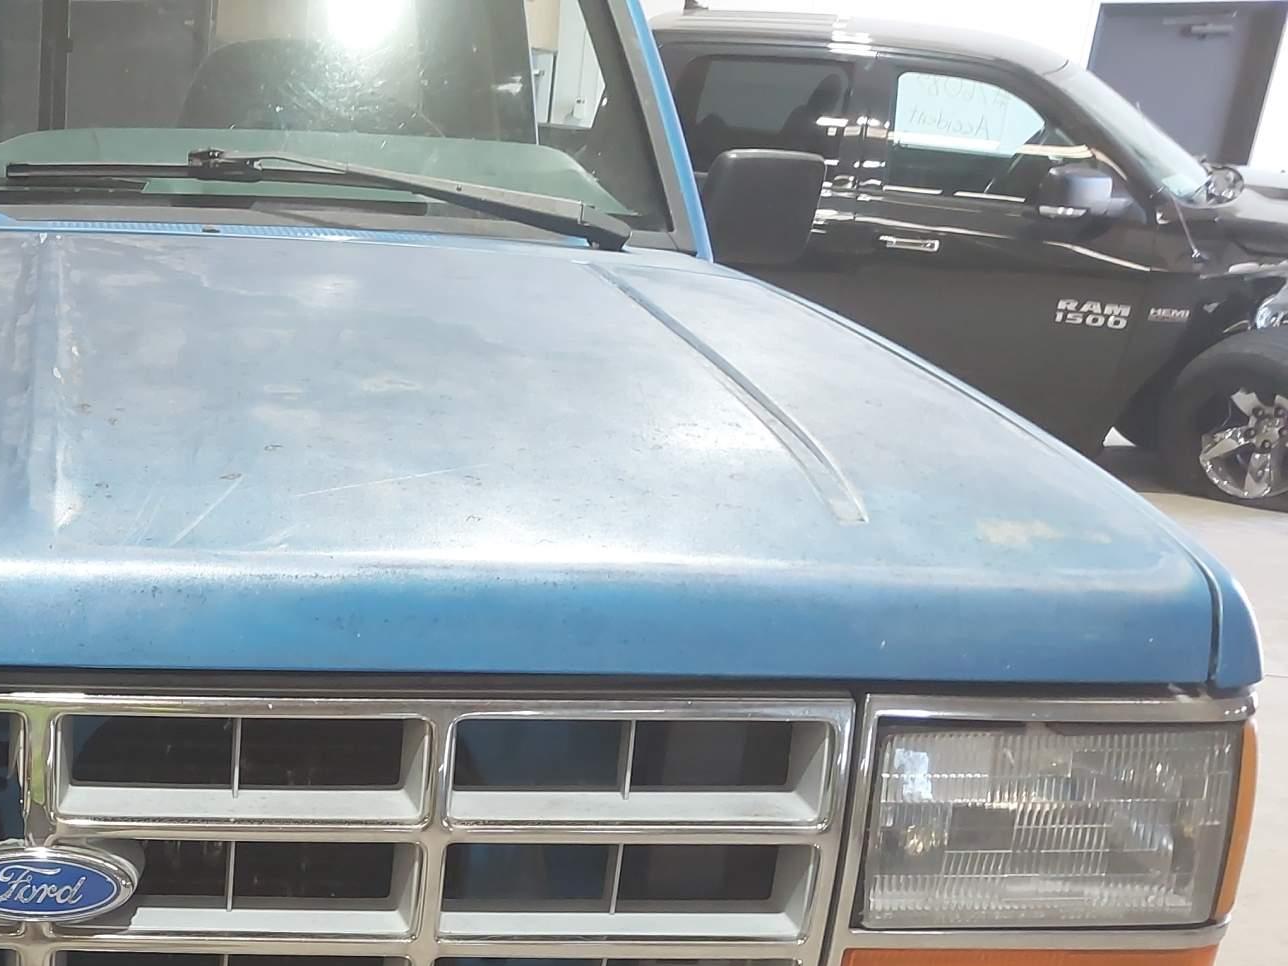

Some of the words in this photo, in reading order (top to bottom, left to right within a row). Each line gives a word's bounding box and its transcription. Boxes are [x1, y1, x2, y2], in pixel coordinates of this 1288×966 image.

[1057, 299, 1131, 317] RAM
[1149, 307, 1190, 318] HEMI
[1055, 311, 1127, 329] 1500
